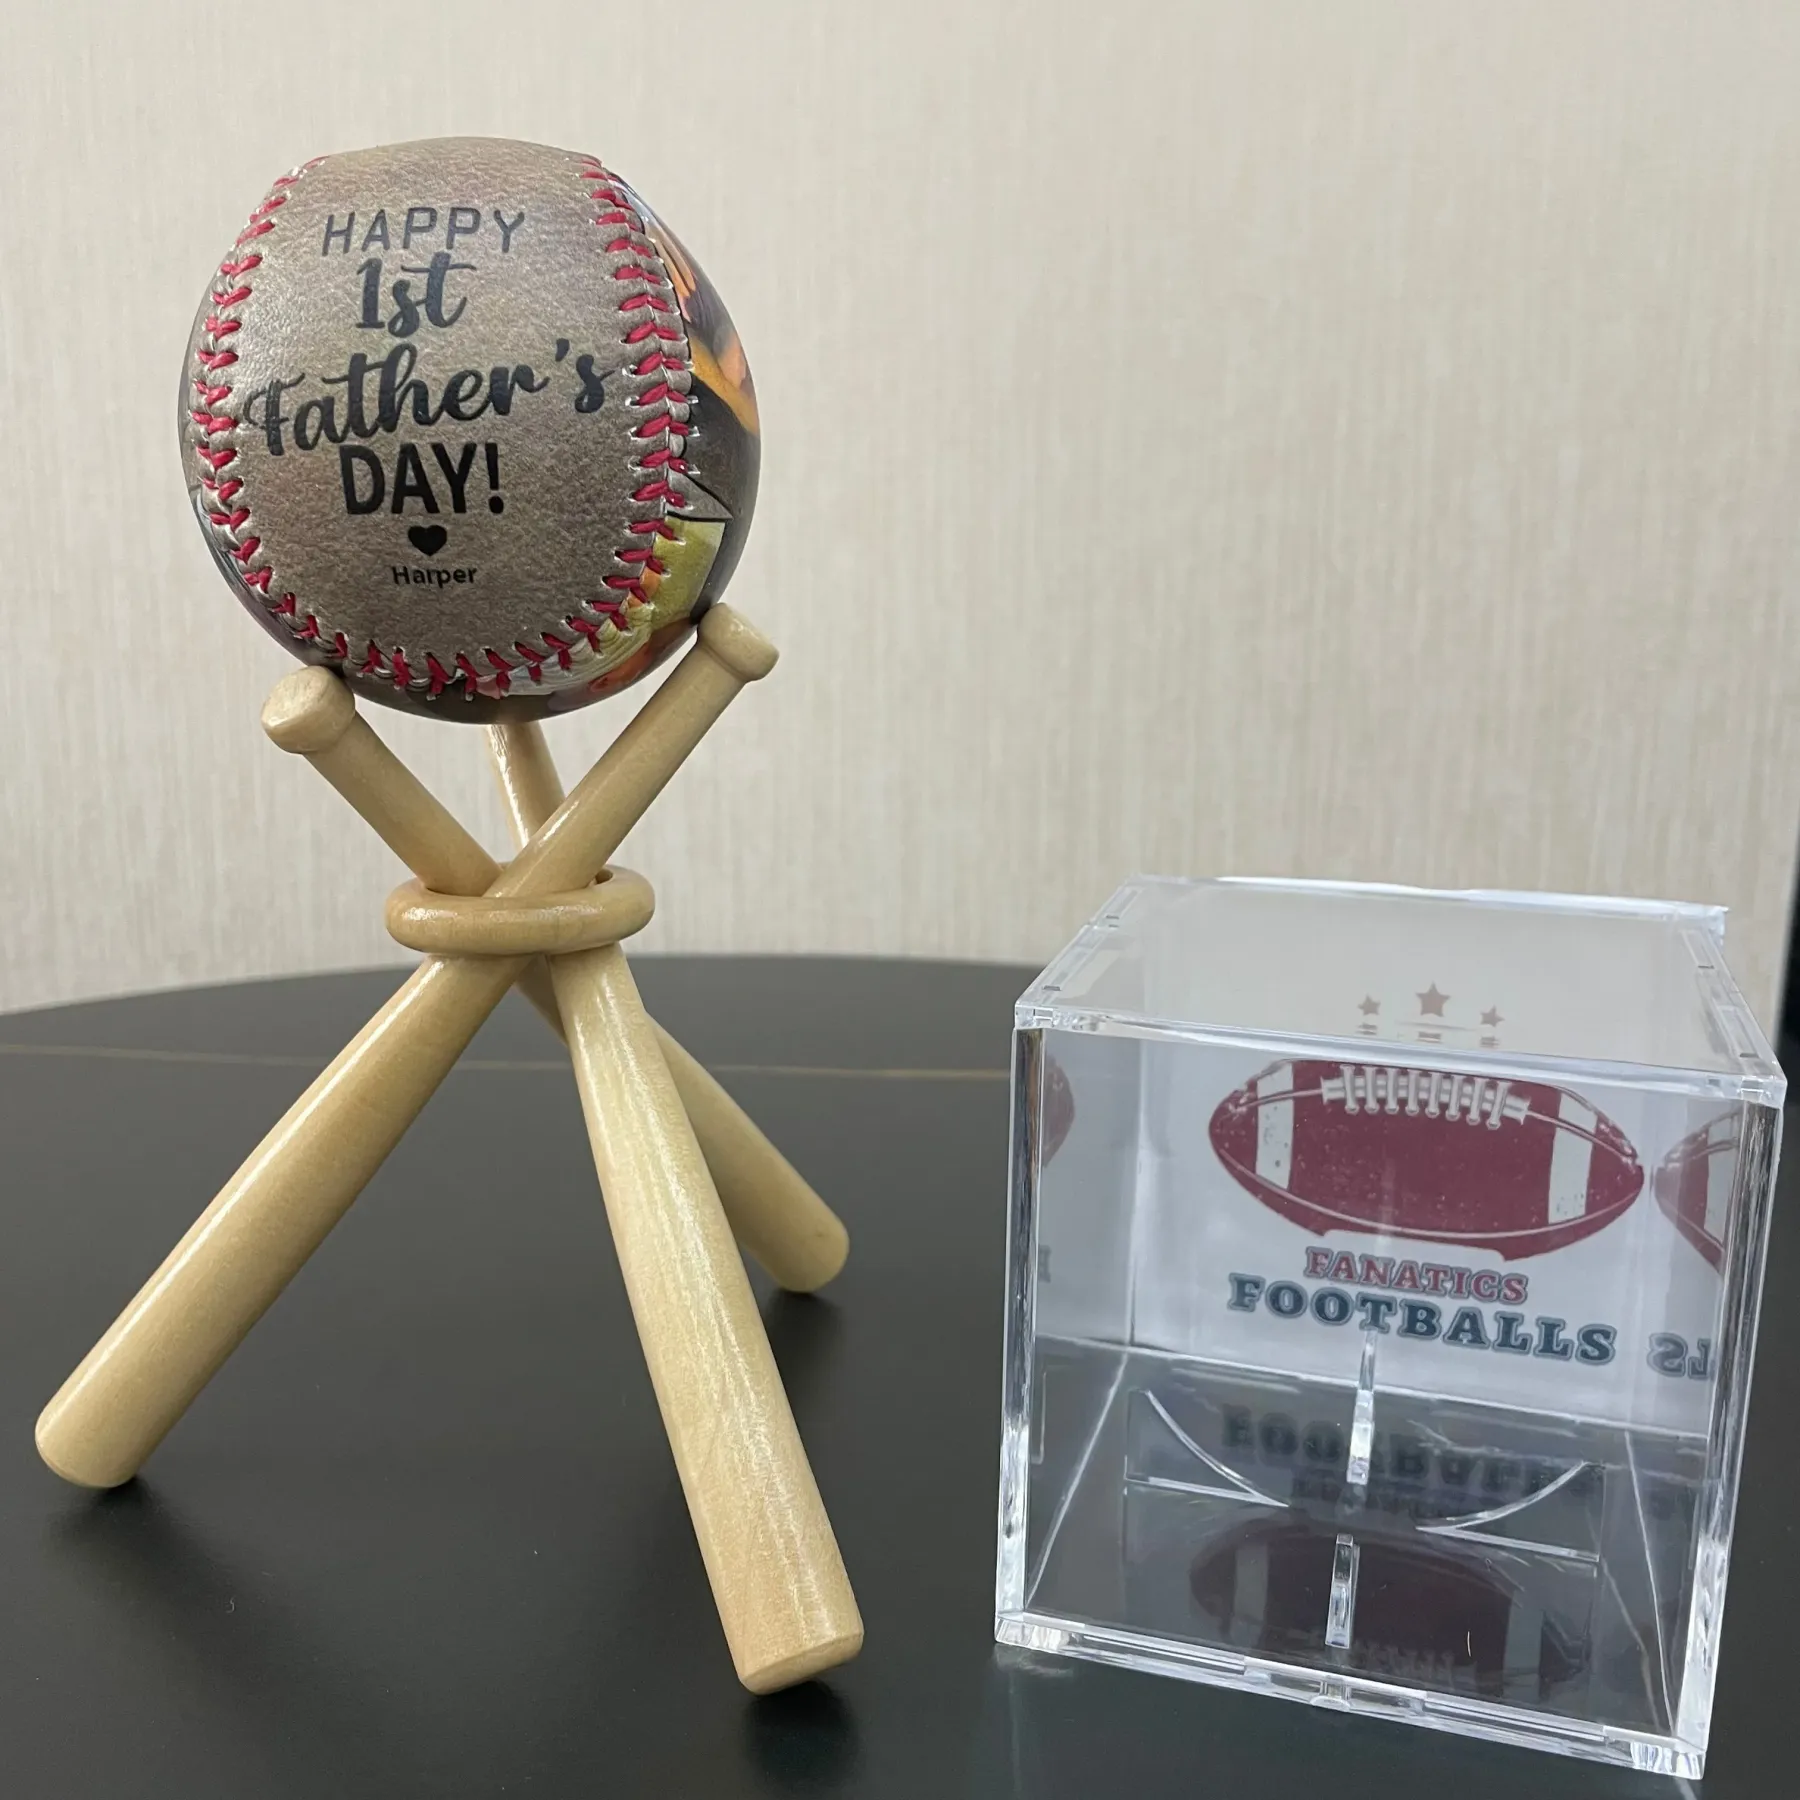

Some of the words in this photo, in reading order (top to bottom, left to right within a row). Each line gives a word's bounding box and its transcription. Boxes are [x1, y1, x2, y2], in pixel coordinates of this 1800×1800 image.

[322, 207, 525, 256] HAPPY
[356, 252, 476, 337] 1st
[244, 338, 616, 456] Father's
[339, 443, 504, 515] DAY!
[392, 564, 477, 588] Harper
[1304, 1246, 1528, 1303] FANATICS
[1227, 1273, 1617, 1364] FOOTBALLS
